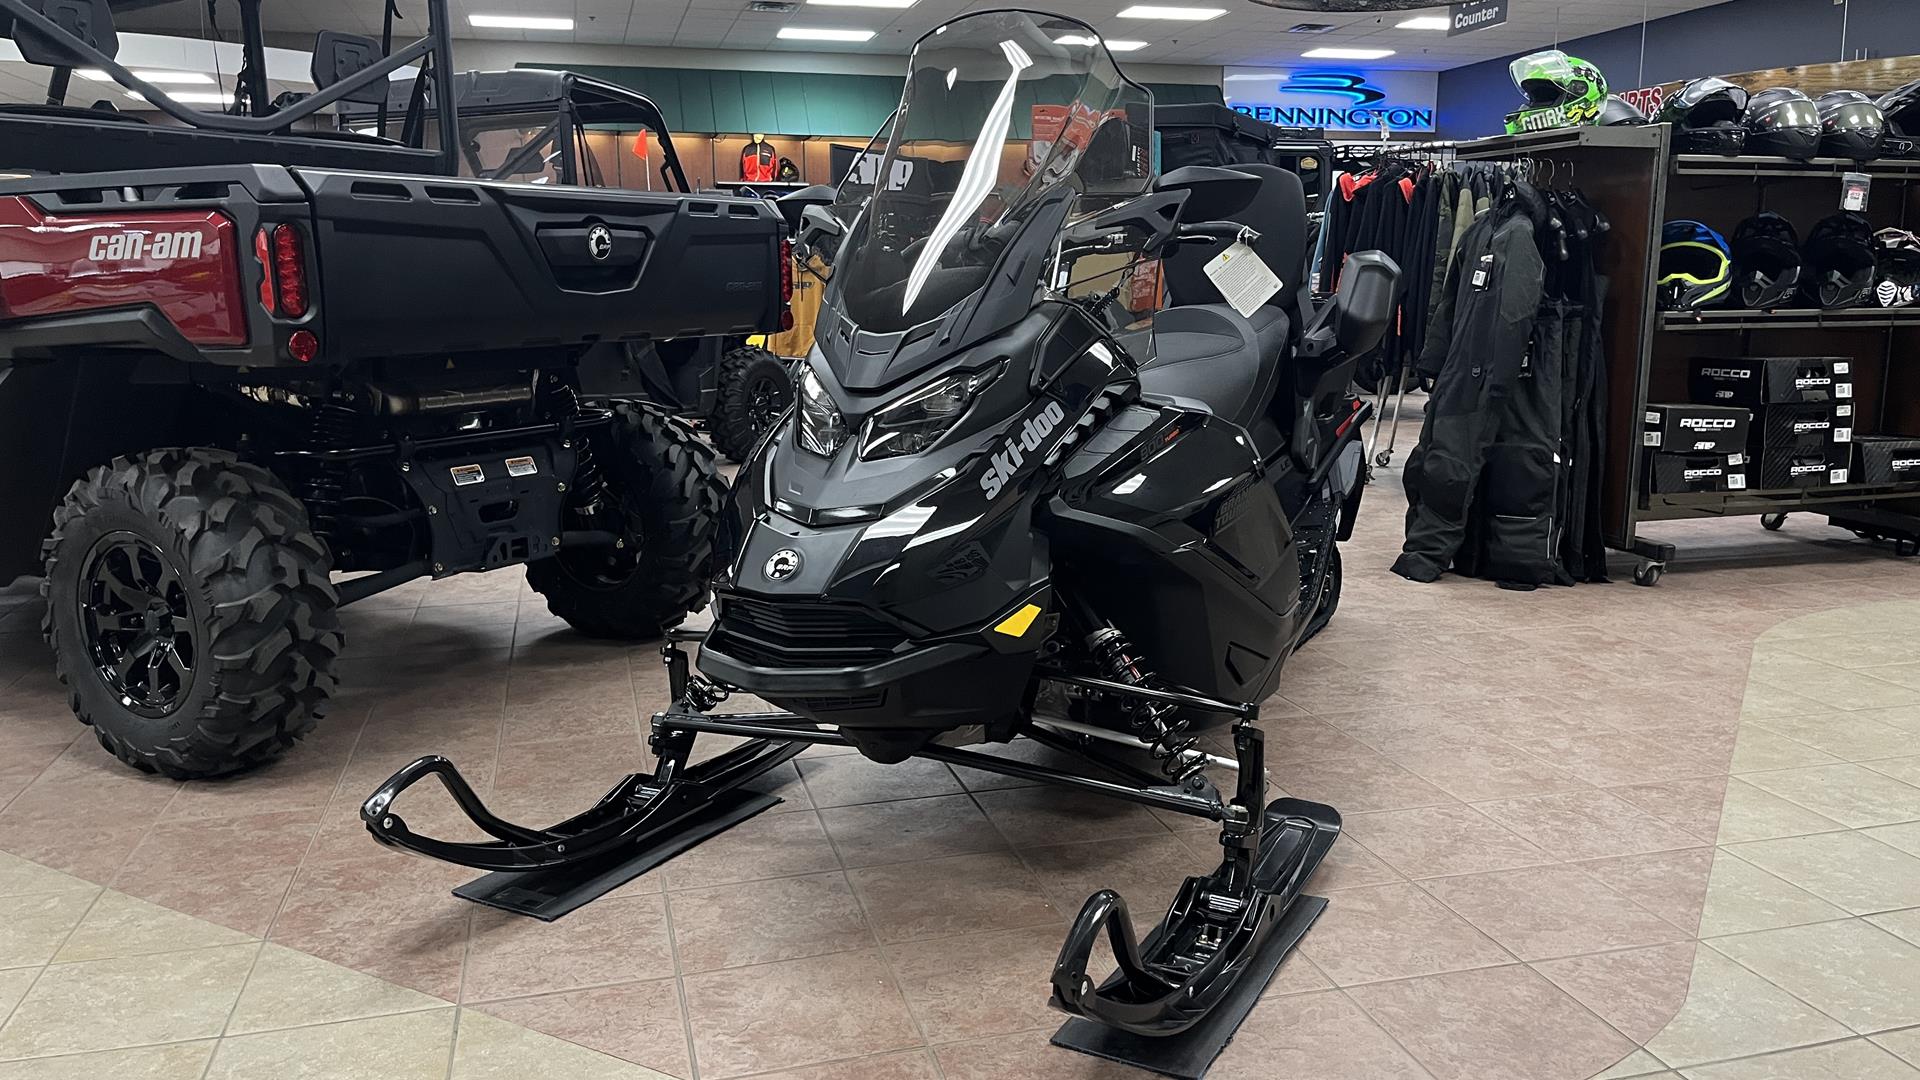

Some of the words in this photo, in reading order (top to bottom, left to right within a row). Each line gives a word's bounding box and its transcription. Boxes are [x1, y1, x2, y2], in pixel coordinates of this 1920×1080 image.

[1454, 6, 1499, 29] Counter
[1232, 105, 1433, 127] BENNINGTON
[1522, 105, 1566, 131] GMAX
[88, 230, 203, 261] can-am
[1701, 368, 1750, 378] ROCCO
[1680, 418, 1736, 428] ROCCO
[1794, 422, 1830, 430] ROCCO
[980, 400, 1065, 501] ski-doo
[1684, 468, 1722, 477] ROCCO
[1790, 465, 1826, 473] ROCCO
